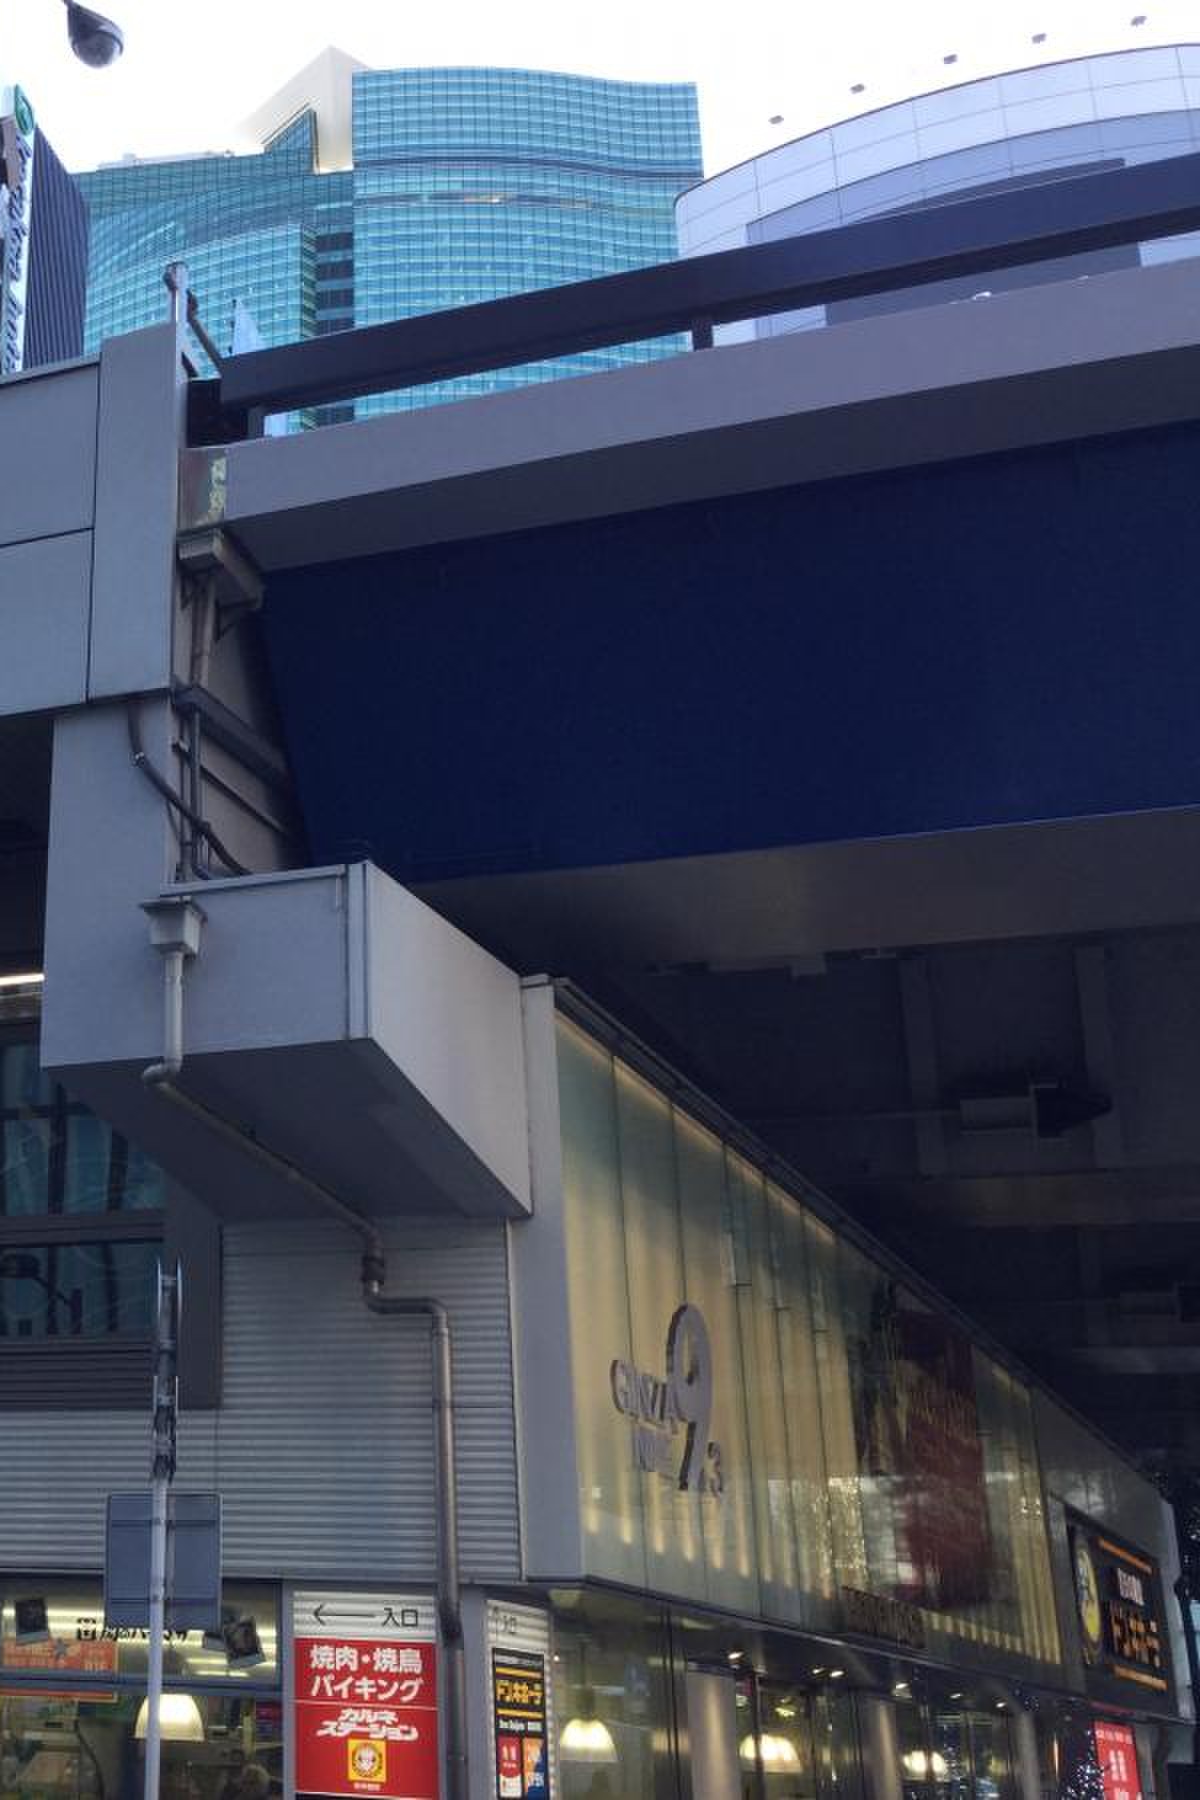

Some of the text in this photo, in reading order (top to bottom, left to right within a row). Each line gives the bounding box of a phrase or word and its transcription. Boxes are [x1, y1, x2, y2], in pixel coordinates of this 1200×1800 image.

[382, 1606, 419, 1628] 入口
[310, 1645, 422, 1674] 焼肉・焼鳥
[311, 1675, 424, 1702] バイキング
